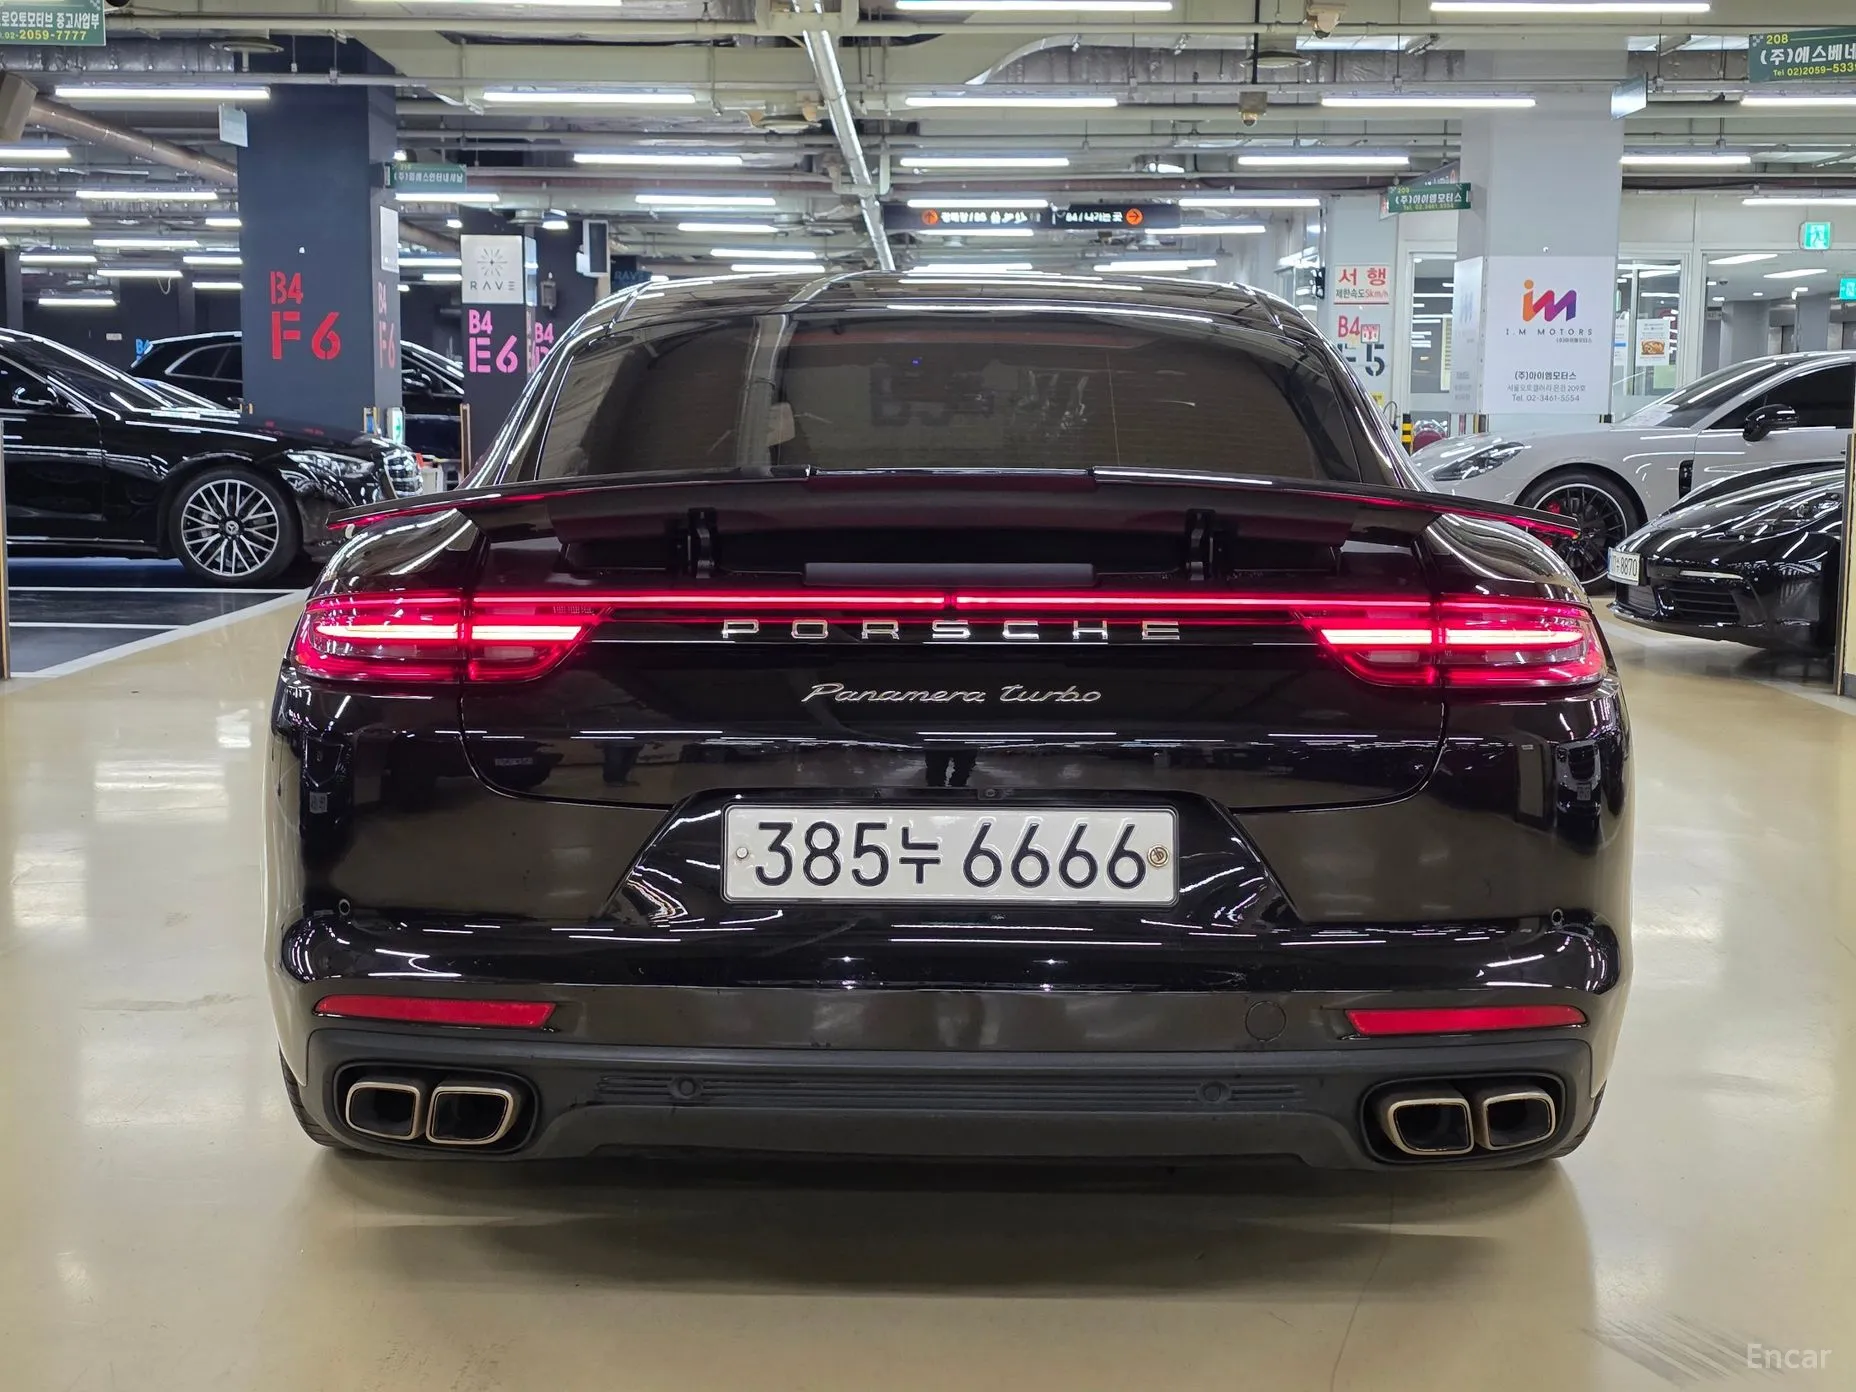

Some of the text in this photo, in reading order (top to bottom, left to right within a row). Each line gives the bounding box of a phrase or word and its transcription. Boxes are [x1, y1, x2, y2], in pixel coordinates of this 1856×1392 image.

[1766, 34, 1789, 45] 208
[1787, 62, 1856, 77] 02)2059-533
[270, 271, 303, 304] B4
[471, 280, 516, 291] RAVE
[468, 309, 493, 334] B4
[1338, 315, 1361, 338] B4
[1537, 328, 1593, 336] MOTORS
[535, 322, 554, 344] B4
[469, 335, 518, 374] E6
[1514, 371, 1577, 381] (주)아이엠모터스
[1526, 394, 1581, 402] 02-3461-5554
[721, 618, 1180, 641] PORSCHE
[801, 682, 1102, 703] Panamera turbo
